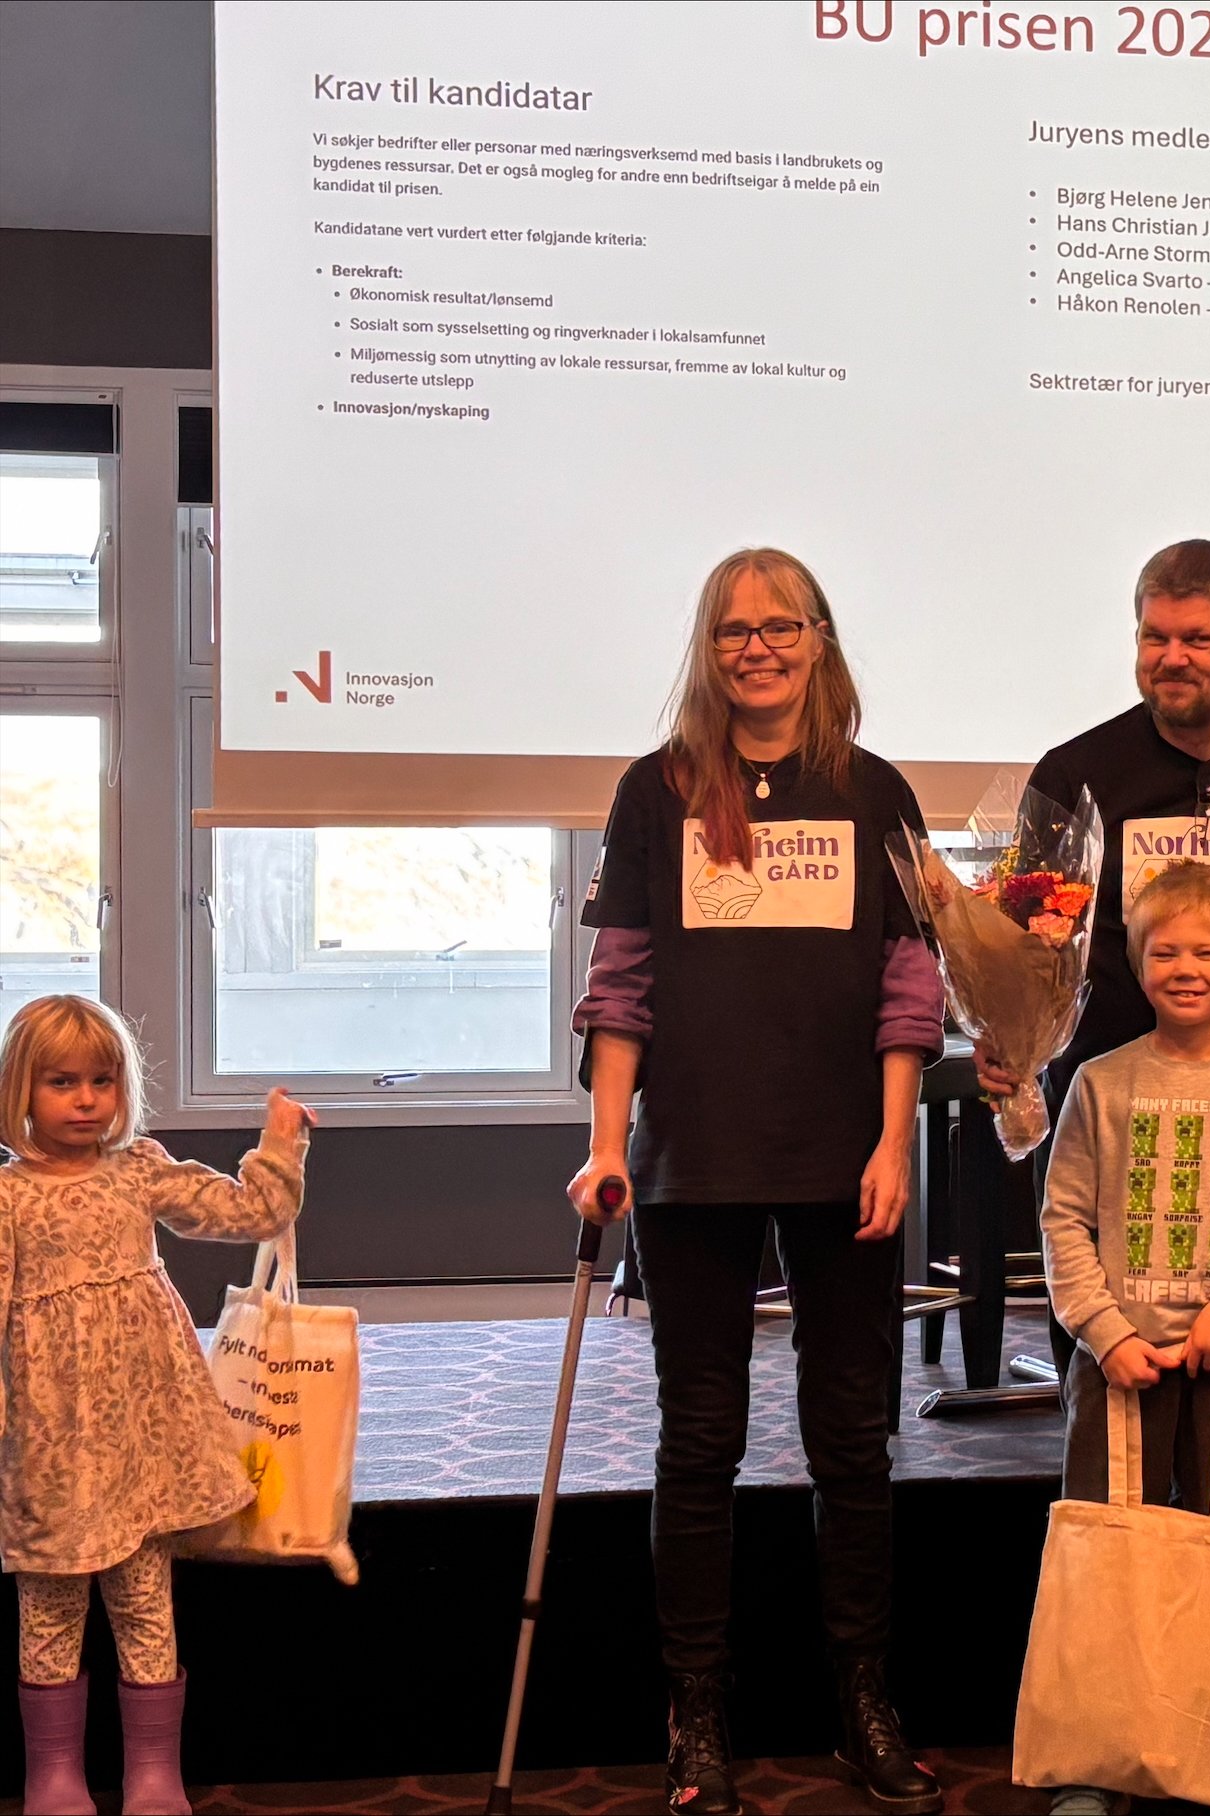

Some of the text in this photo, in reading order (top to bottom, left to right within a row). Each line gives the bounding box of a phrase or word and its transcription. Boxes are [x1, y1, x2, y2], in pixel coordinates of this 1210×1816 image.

[813, 0, 893, 43] BU
[919, 0, 1095, 57] prisen
[314, 73, 593, 111] Krav til kandidatar
[1027, 119, 1124, 149] Juryens
[312, 132, 883, 174] Vi søkjer bedrifter eller personar med næringsverksemd med basis i landbrukets og
[312, 154, 880, 195] bygdenes ressursar. Det er også mogleg for andre enn bedriftseigar å melde på ein
[312, 176, 443, 198] kandidat til prisen.
[1057, 187, 1106, 210] Bjørg
[1110, 189, 1178, 209] Helene
[314, 220, 647, 247] Kandidatane vert vurdert etter følgjande kriteria:
[1057, 213, 1107, 233] Hans
[1111, 216, 1198, 237] Christian
[1056, 241, 1150, 261] Odd-Arne
[331, 264, 404, 279] Berekraft:
[1056, 267, 1138, 290] Angelica
[1142, 271, 1204, 290] Svarto
[349, 287, 554, 308] Økonomisk resultat/lønsemd
[1057, 292, 1119, 313] Håkon
[1123, 296, 1201, 316] Renolen
[349, 317, 766, 346] Sosialt som sysselsetting og ringverknader i lokalsamfunnet
[350, 347, 847, 382] Miljømessig som utnytting av lokale ressursar, fremme av lokal kultur og
[350, 370, 475, 391] reduserte utslepp
[1029, 372, 1124, 392] Sektretær
[1127, 376, 1154, 393] for
[333, 400, 490, 421] Innovasjon/nyskaping
[345, 671, 434, 690] Innovasjon
[346, 690, 396, 708] Norge
[693, 827, 840, 859] Nheim
[767, 859, 840, 882] GÅRD
